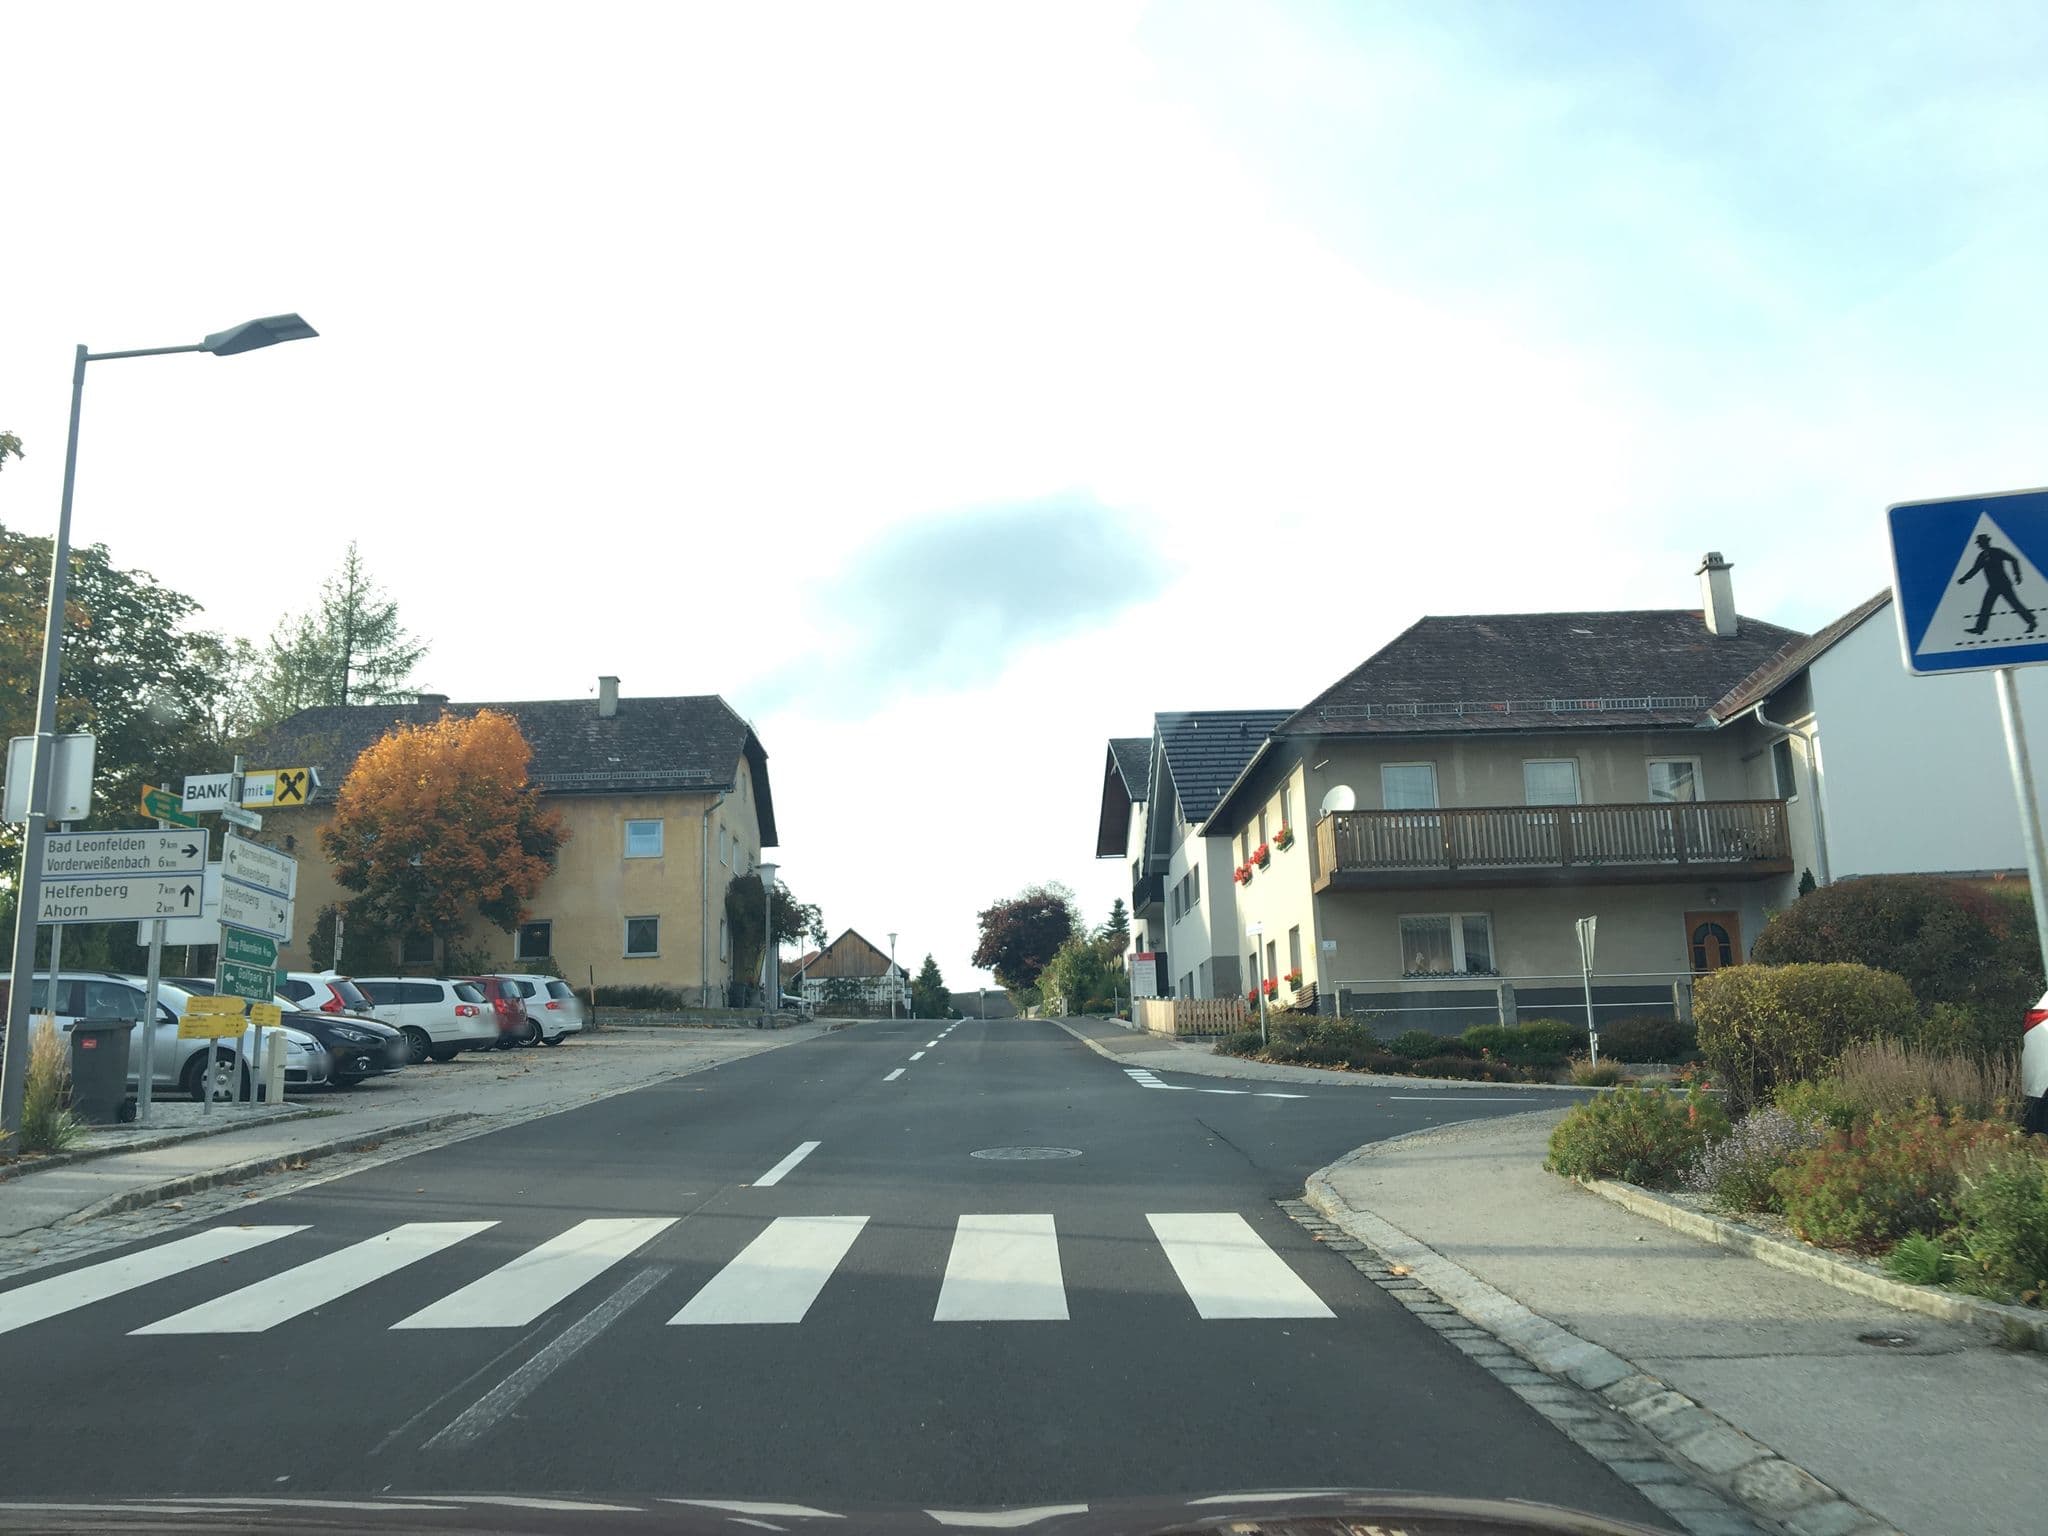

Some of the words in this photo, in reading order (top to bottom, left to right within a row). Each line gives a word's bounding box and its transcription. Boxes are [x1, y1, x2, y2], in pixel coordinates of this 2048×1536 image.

[186, 783, 228, 800] BANK
[48, 840, 71, 853] Bad
[76, 838, 146, 852] Leonfelden
[47, 856, 150, 871] Vorderweißenbach
[45, 884, 128, 899] Helfenberg
[43, 904, 88, 917] Ahorn
